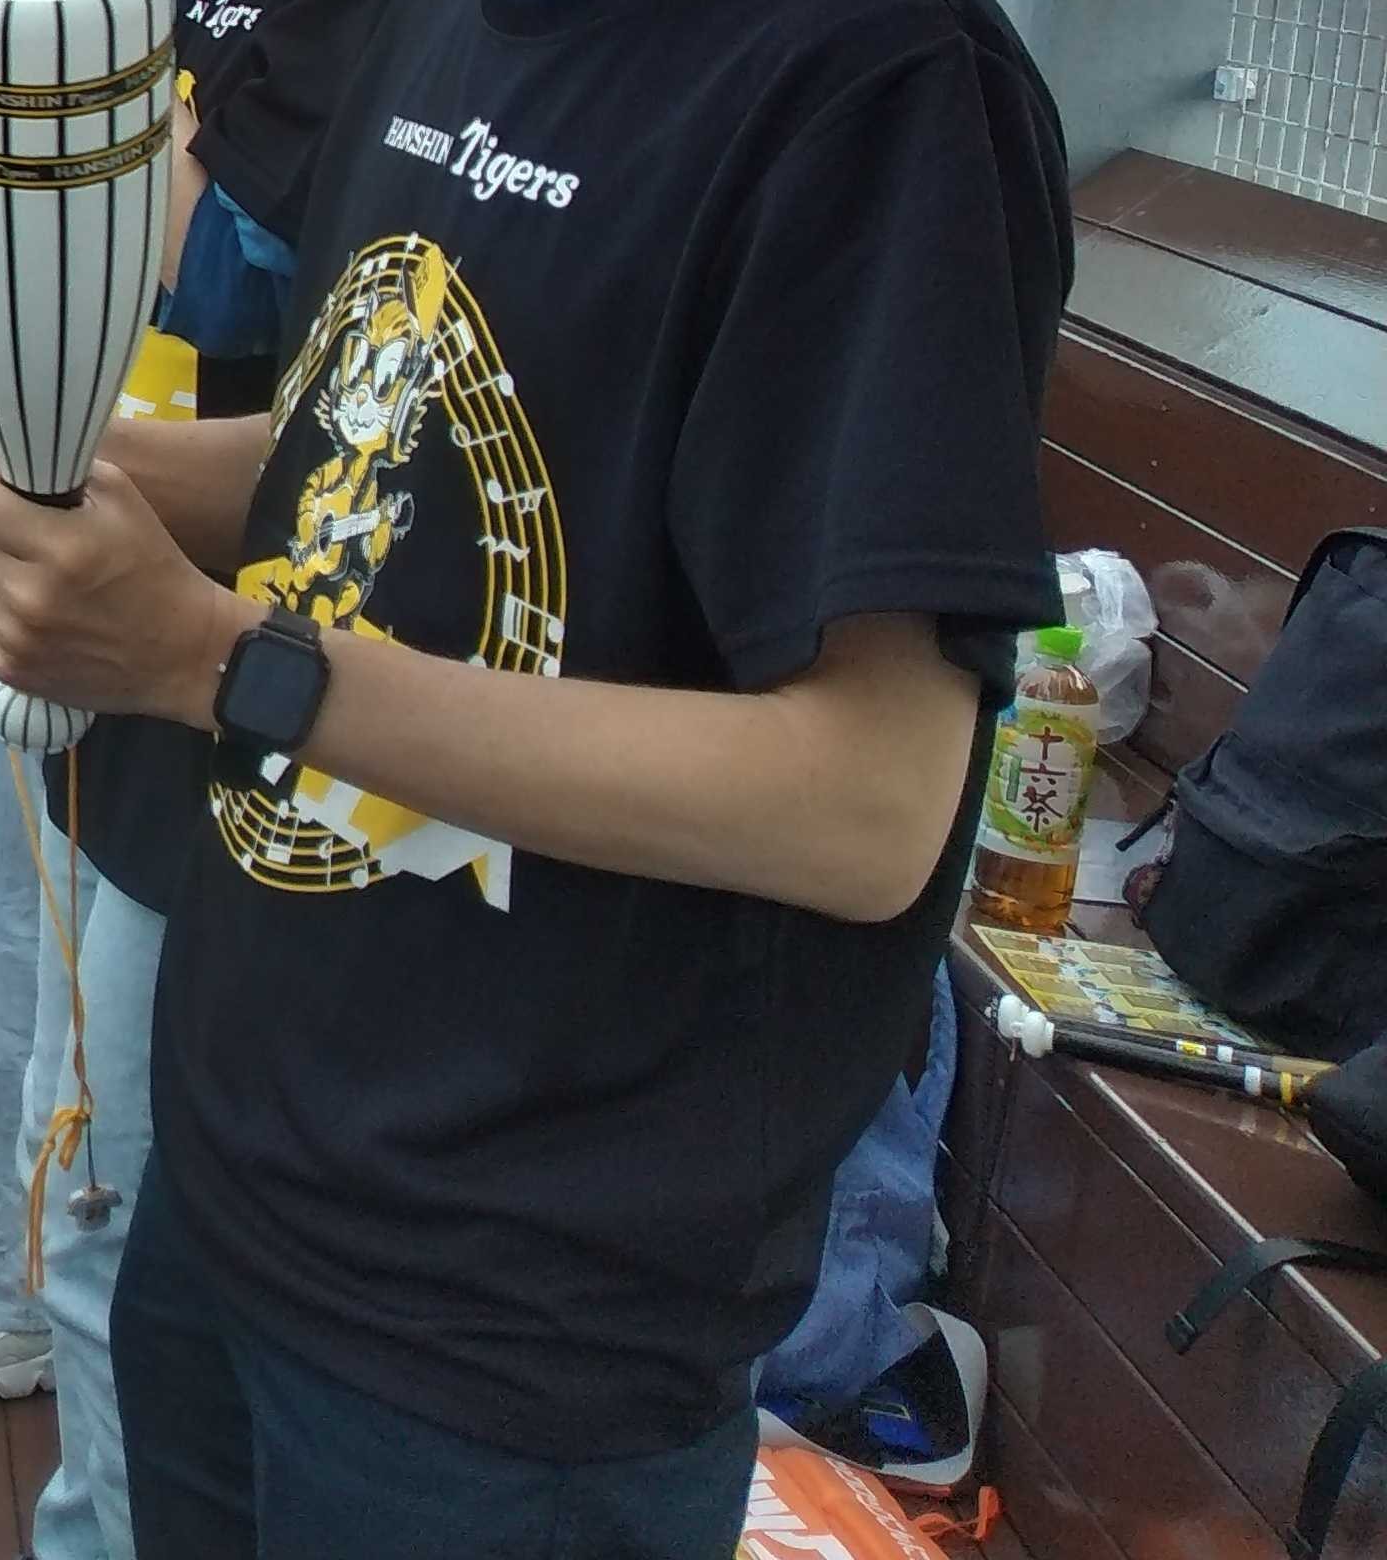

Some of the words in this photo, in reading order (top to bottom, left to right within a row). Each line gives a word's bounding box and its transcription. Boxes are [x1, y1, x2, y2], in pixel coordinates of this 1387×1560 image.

[54, 143, 144, 179] HANSHIN
[384, 115, 455, 166] HANSHIN
[450, 116, 580, 209] Tigers
[1021, 725, 1067, 834] 十六茶
